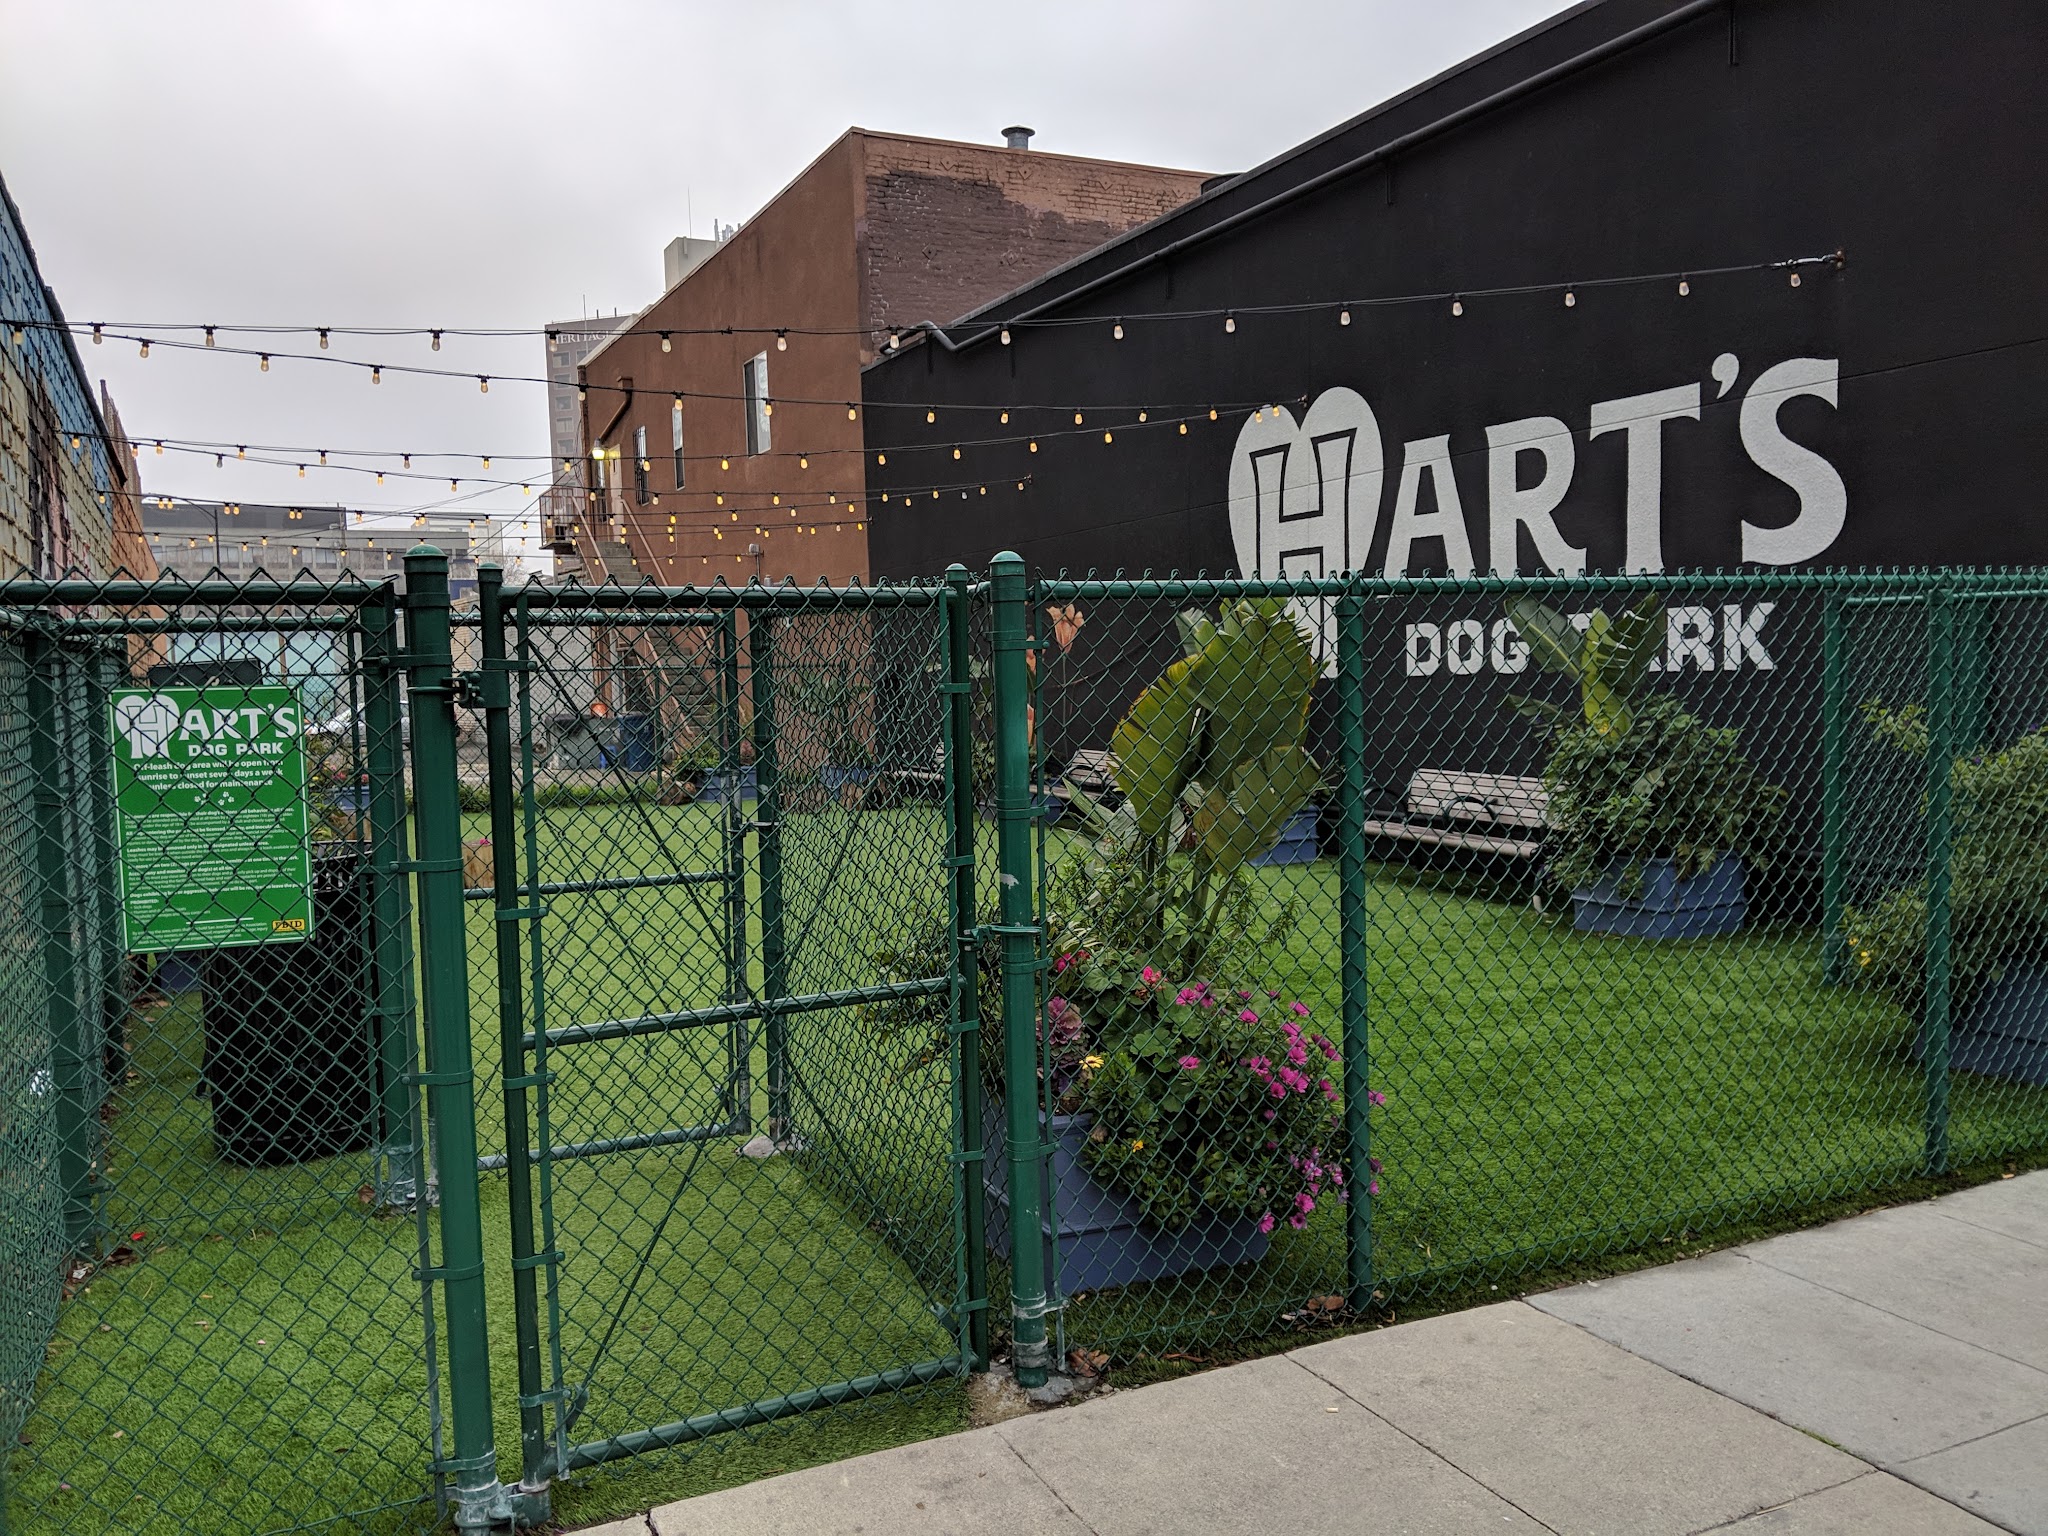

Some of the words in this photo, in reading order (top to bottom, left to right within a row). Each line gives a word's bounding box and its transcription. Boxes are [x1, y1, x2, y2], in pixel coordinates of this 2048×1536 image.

[1230, 353, 1848, 678] HART'S
[1406, 618, 1531, 677] DOG
[1567, 602, 1778, 672] RK
[116, 695, 298, 759] HART'S
[188, 743, 228, 757] DOG
[235, 741, 284, 755] PARK
[241, 760, 262, 769] open
[234, 769, 254, 778] days
